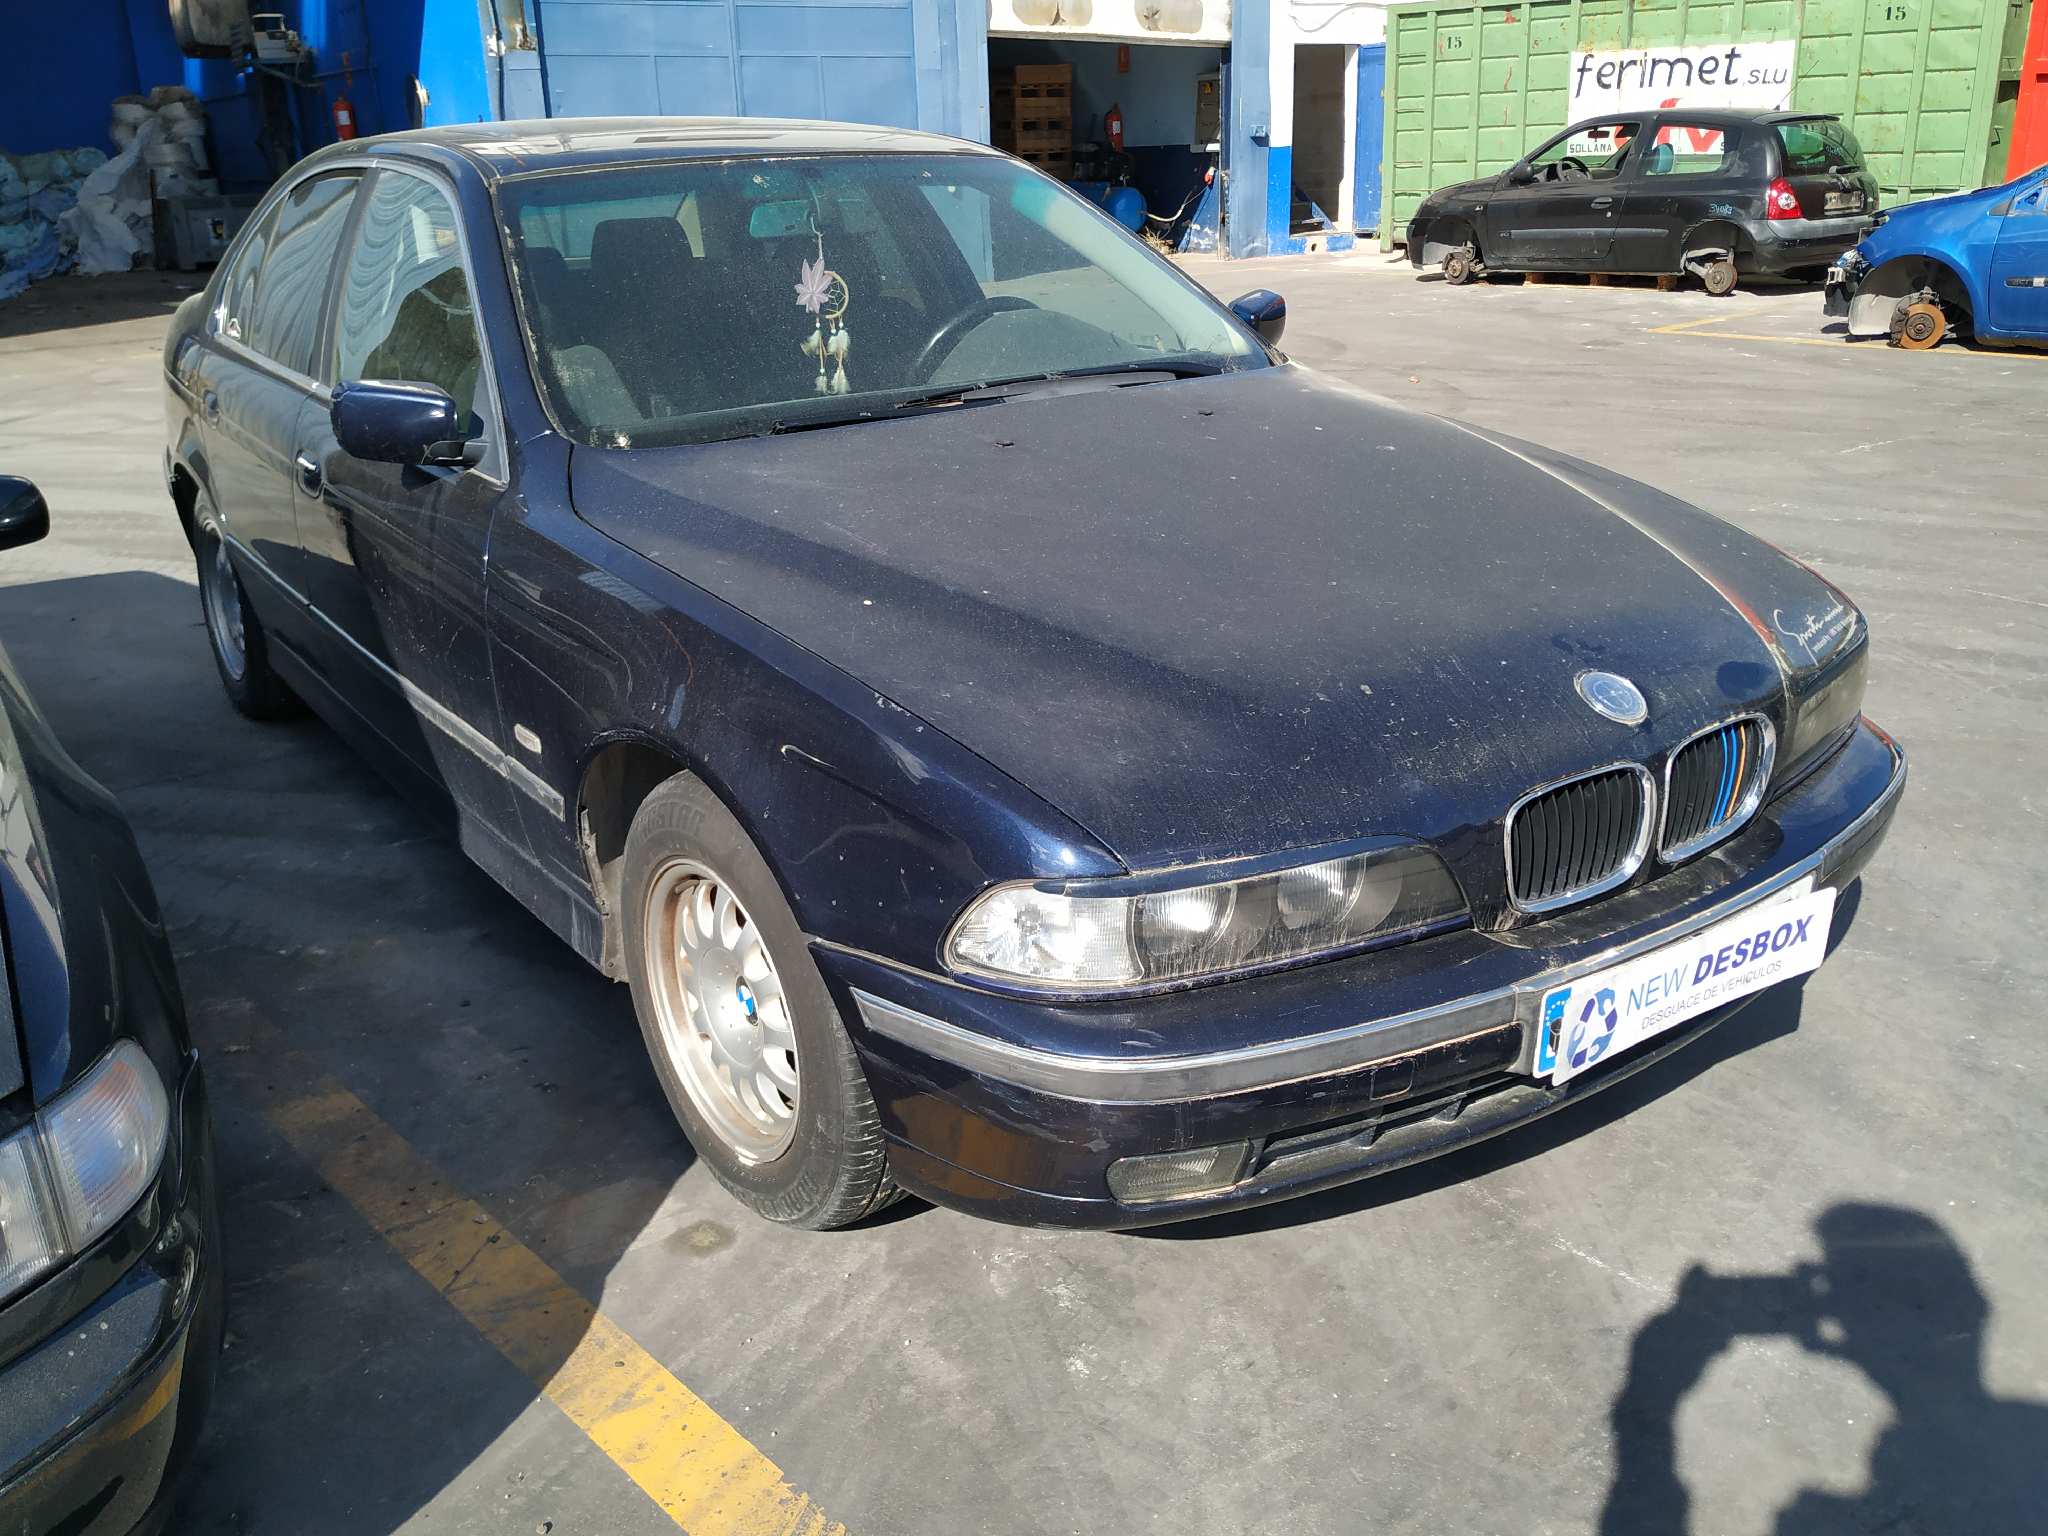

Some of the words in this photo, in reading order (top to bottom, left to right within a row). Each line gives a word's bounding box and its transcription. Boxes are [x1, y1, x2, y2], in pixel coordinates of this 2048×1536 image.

[1887, 6, 1906, 20] 15
[1447, 36, 1462, 49] 15
[1575, 47, 1742, 98] ferimet
[1569, 144, 1612, 153] SOLLANA
[1626, 963, 1688, 1016] NEW
[1692, 914, 1815, 986] DESBOX
[1641, 993, 1701, 1030] DESGUACE
[1703, 985, 1720, 1000] DE
[1721, 960, 1782, 993] VEHICULOS
